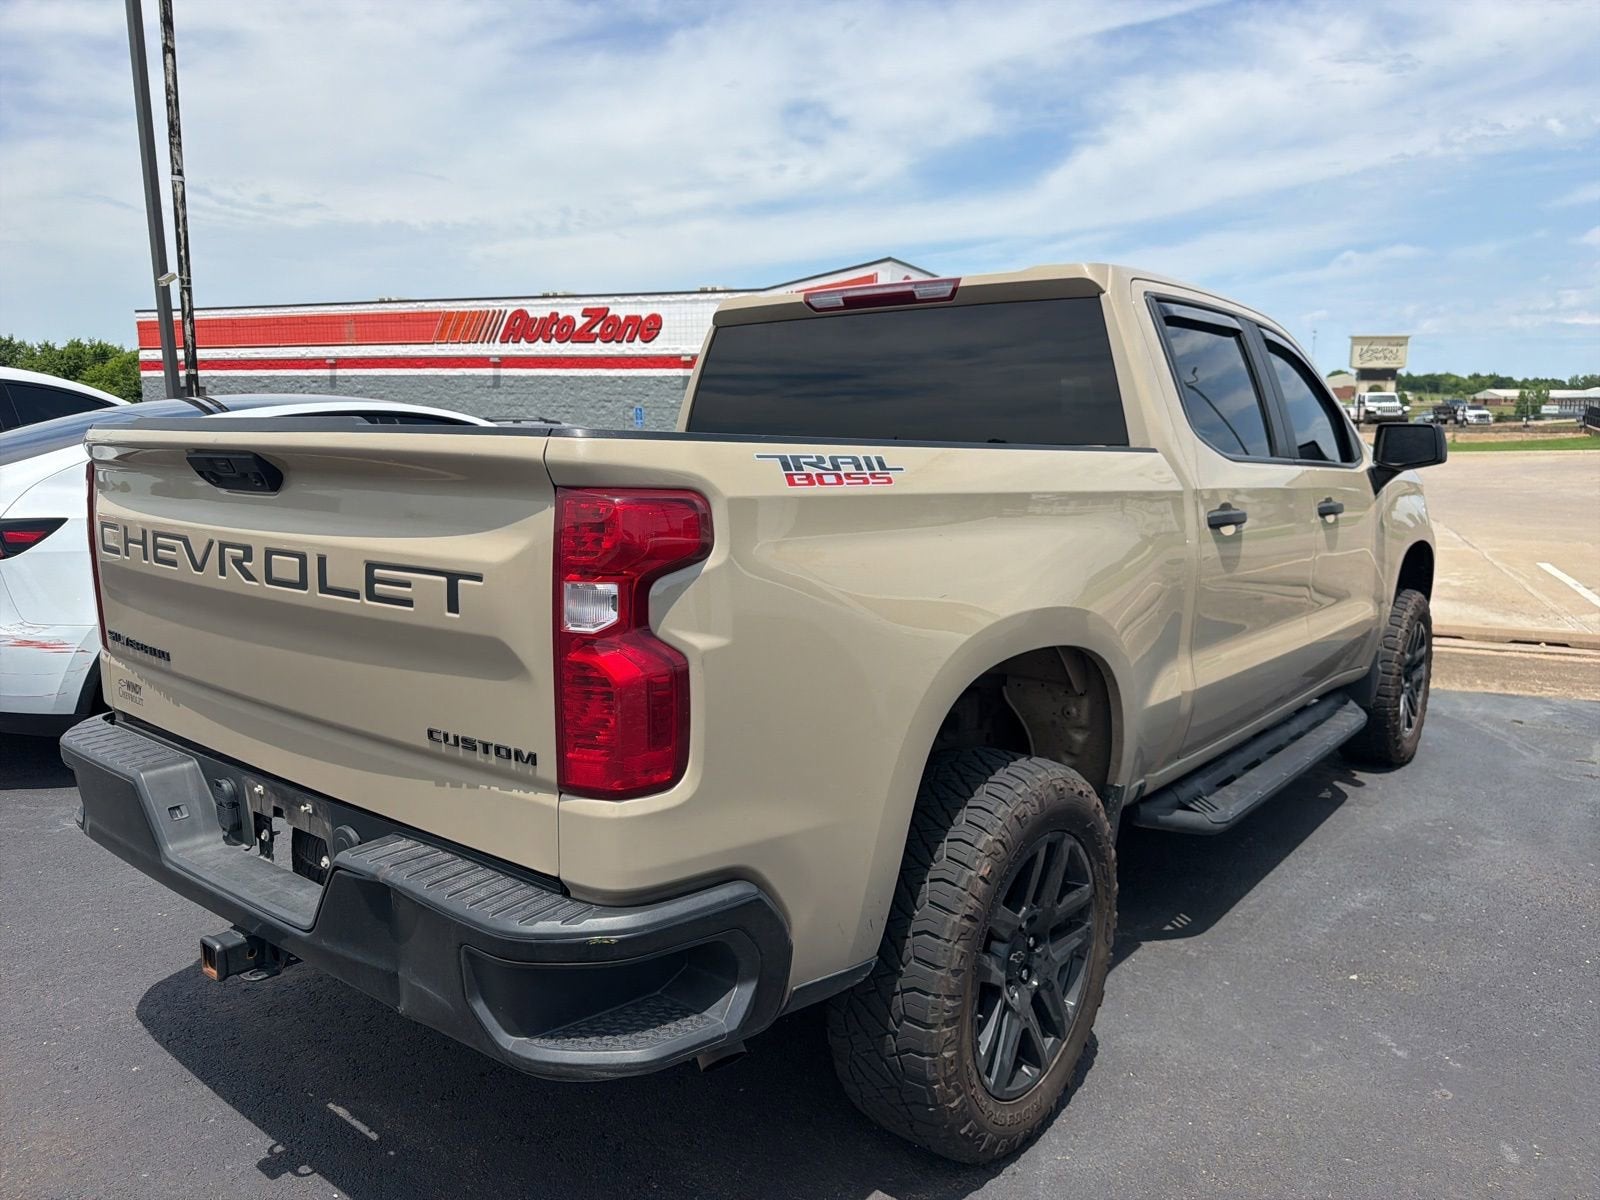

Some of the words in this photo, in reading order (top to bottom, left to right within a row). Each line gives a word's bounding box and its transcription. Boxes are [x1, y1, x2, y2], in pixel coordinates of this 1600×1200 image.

[500, 306, 663, 344] AutoZone
[756, 454, 904, 472] TRAIL
[785, 472, 894, 487] BOSS
[99, 521, 484, 616] CHEVROLET
[126, 680, 142, 696] WINDY
[427, 728, 538, 766] CUSTOM
